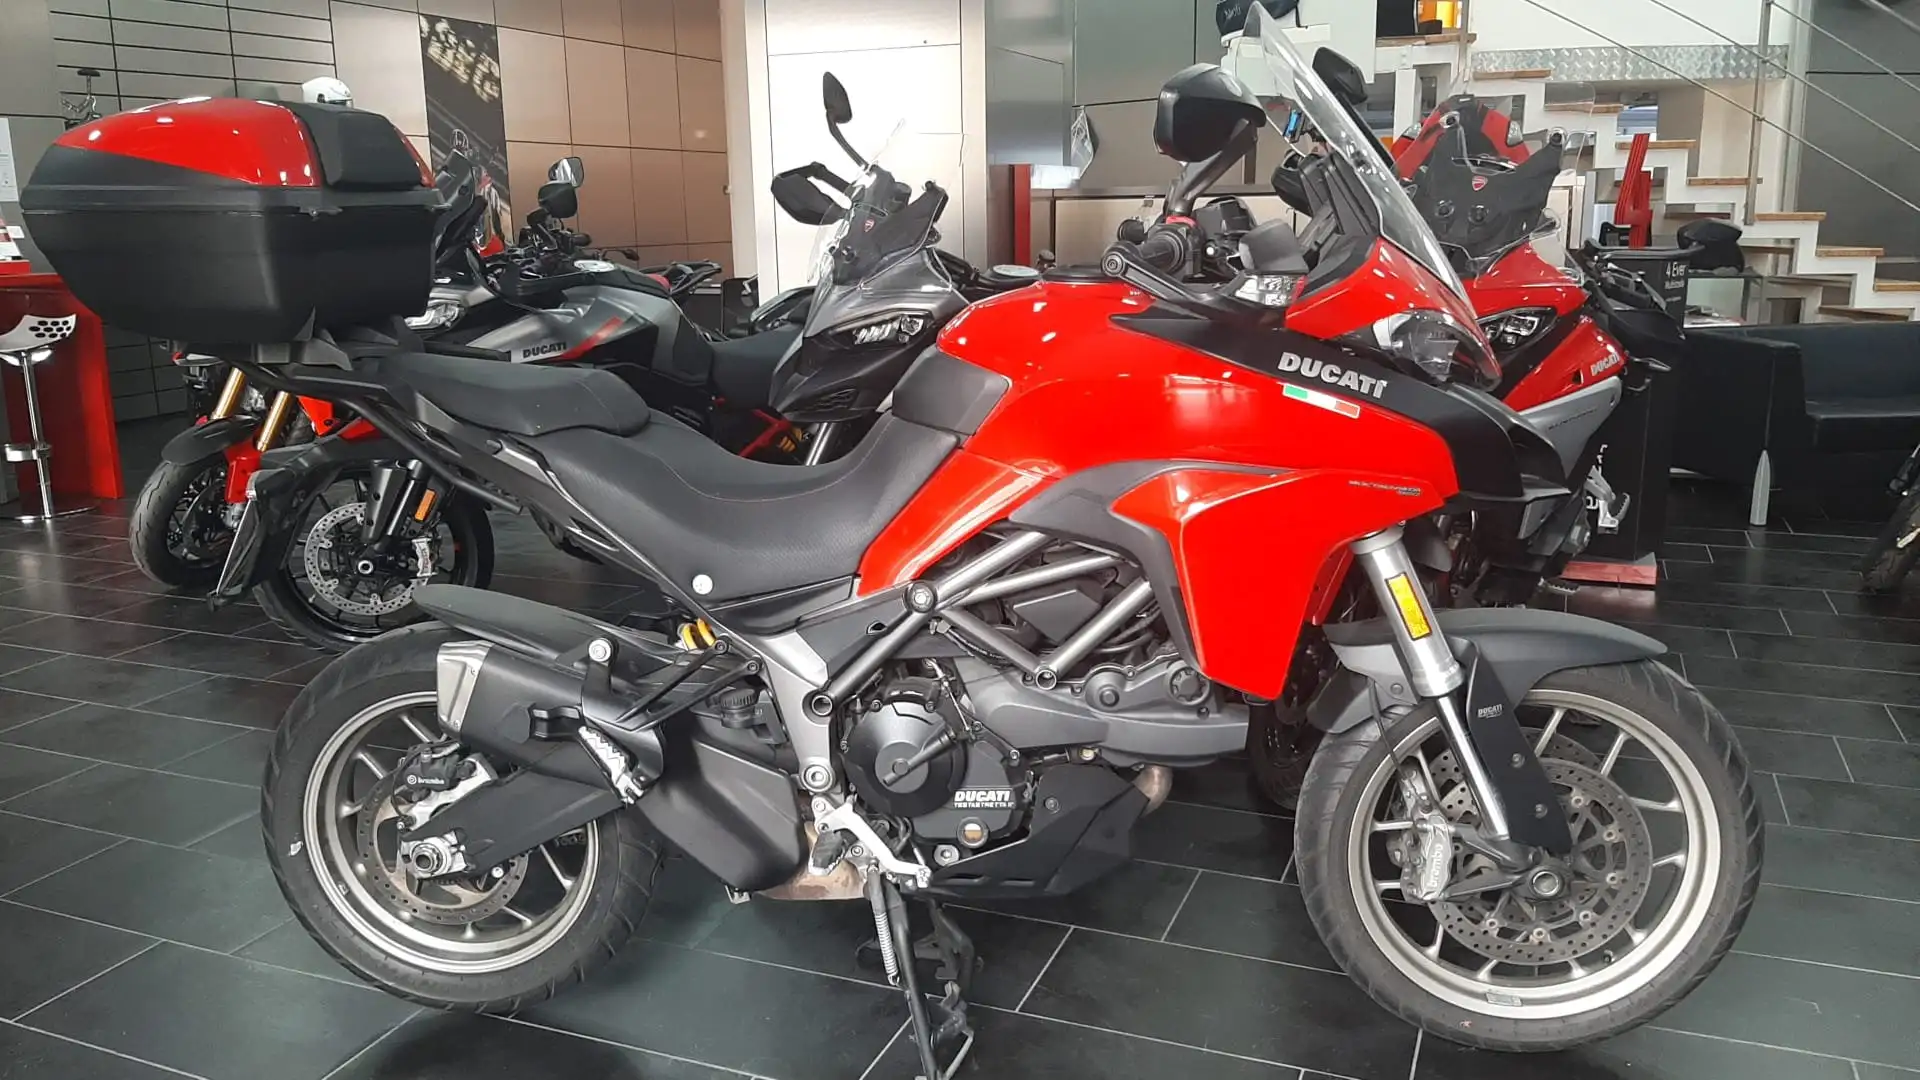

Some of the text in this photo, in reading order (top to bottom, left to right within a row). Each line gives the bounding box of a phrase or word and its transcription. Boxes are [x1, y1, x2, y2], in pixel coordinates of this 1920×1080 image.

[522, 341, 567, 359] DUCATI
[1277, 351, 1388, 399] DUCATI
[1478, 703, 1503, 715] DUCATI
[954, 790, 1011, 802] DUCATI
[1426, 843, 1444, 888] brembo
